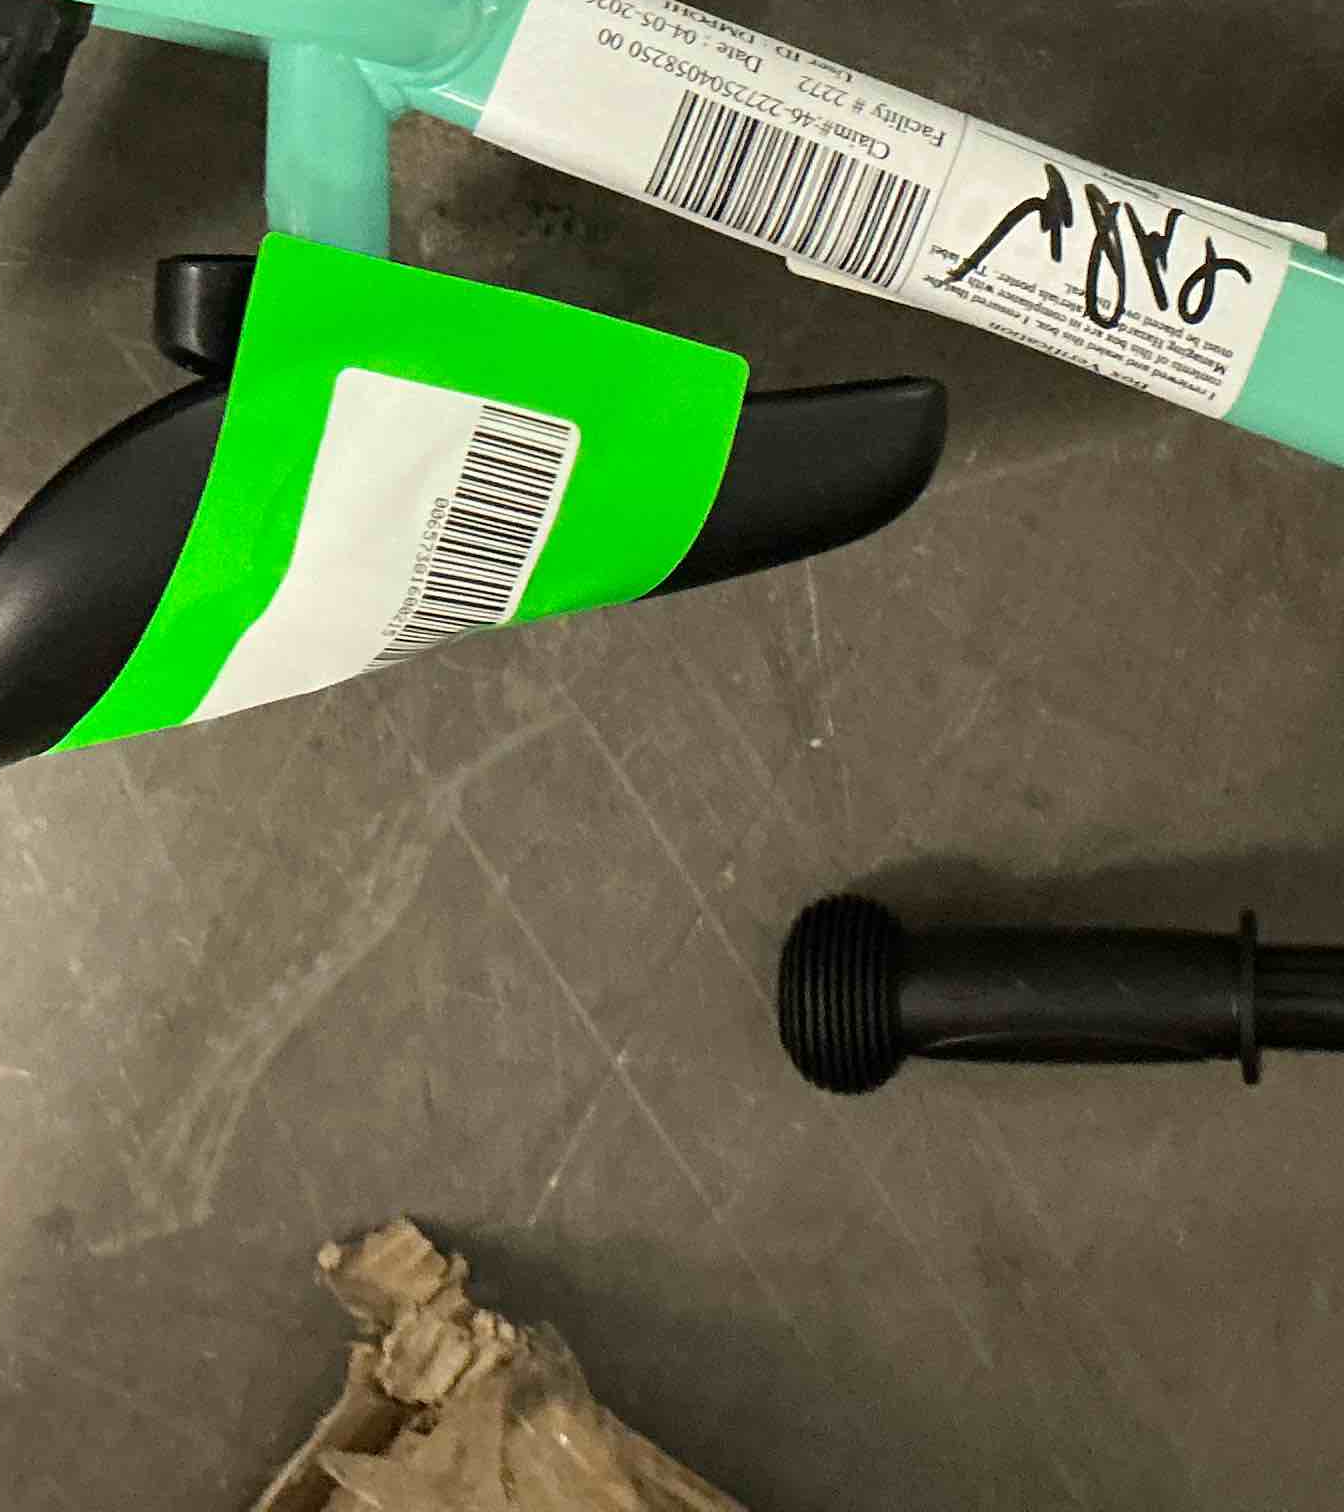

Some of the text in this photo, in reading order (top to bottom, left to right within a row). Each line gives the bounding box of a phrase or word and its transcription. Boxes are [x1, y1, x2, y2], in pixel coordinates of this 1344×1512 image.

[595, 25, 625, 51] 00
[711, 39, 763, 73] Date
[795, 73, 848, 108] 2272
[850, 96, 866, 114] #
[868, 100, 947, 147] Facility
[1125, 357, 1150, 373] and
